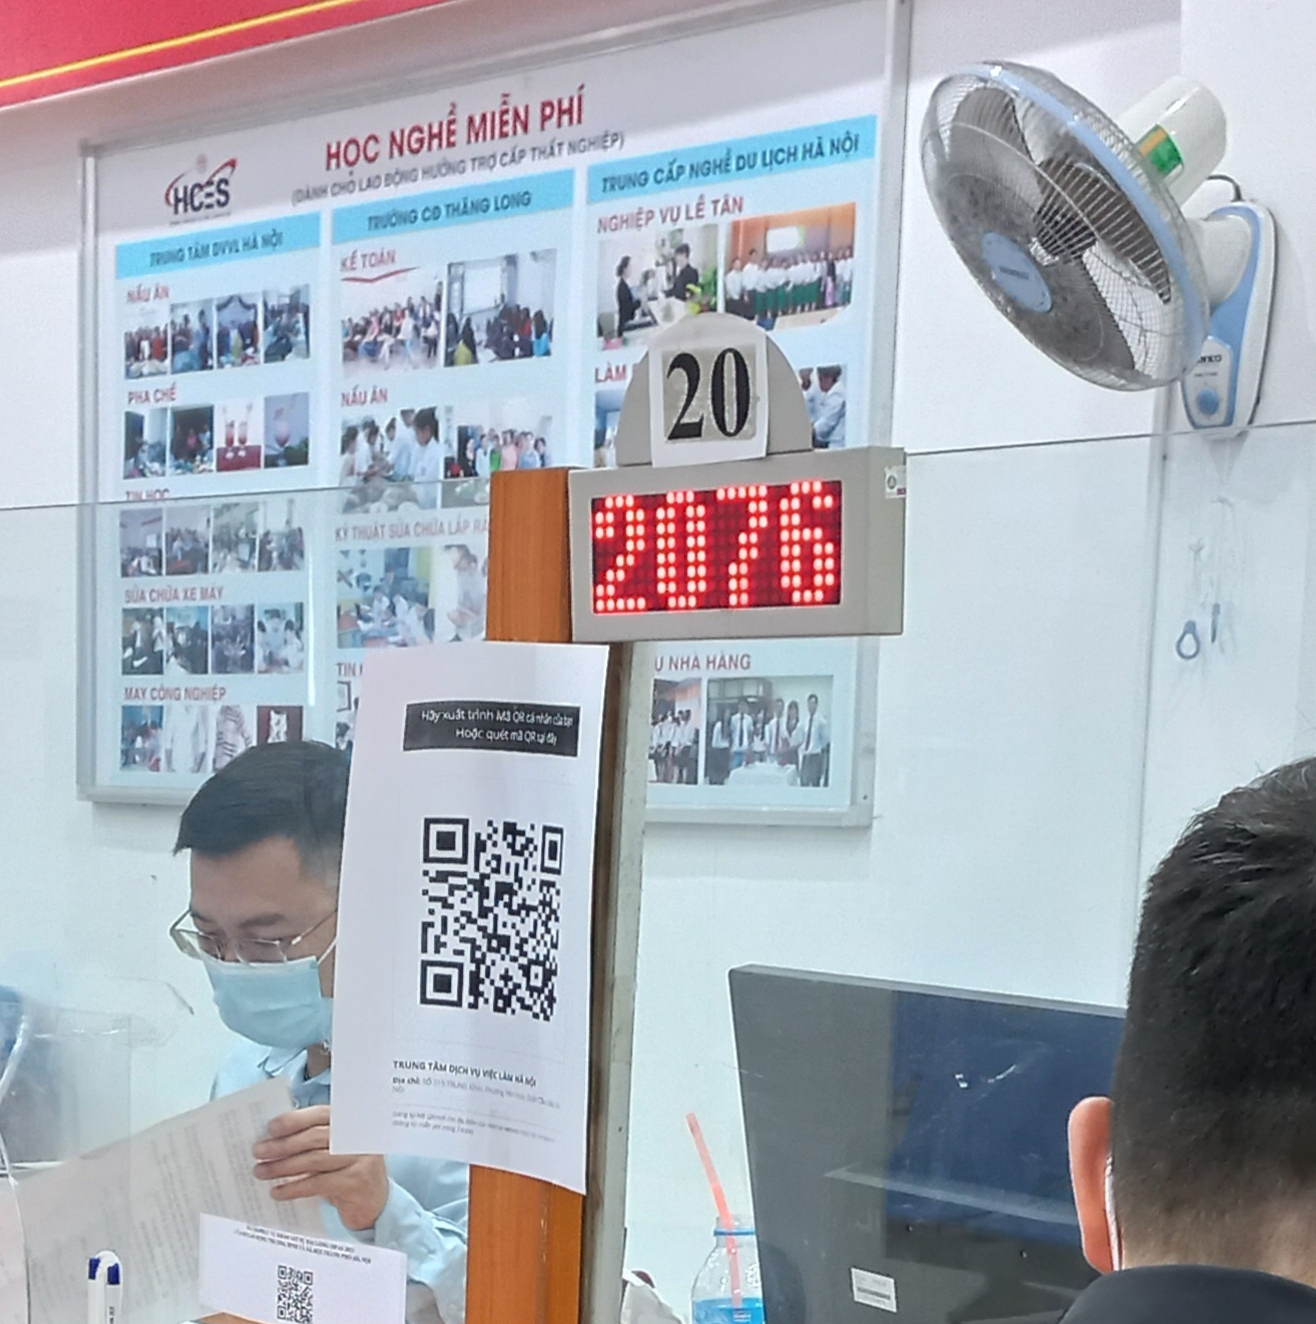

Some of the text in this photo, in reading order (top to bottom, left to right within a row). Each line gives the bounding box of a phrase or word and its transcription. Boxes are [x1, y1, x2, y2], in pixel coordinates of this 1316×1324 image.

[325, 83, 585, 176] HỌC NGHỀ MIỄN PHÍ
[602, 131, 859, 193] TRUNG CẤP NGHỀ DU LỊCH HÀ NỘI
[493, 191, 532, 212] LONG
[597, 208, 655, 234] NGHIỆP
[660, 206, 681, 225] VỤ
[711, 195, 744, 216] TÂN
[595, 361, 627, 383] LÀM
[128, 388, 151, 405] PHA
[666, 347, 751, 441] 20
[595, 480, 834, 612] 2076
[336, 662, 356, 677] TIN
[669, 651, 701, 671] NHÀ
[706, 650, 751, 671] HÀNG
[467, 708, 494, 721] trình
[486, 728, 509, 742] quét
[393, 1060, 426, 1071] TRUNG
[427, 1061, 447, 1072] TÂM
[449, 1066, 469, 1077] DỊCH
[470, 1068, 481, 1078] VỤ
[483, 1069, 498, 1080] VIỆC
